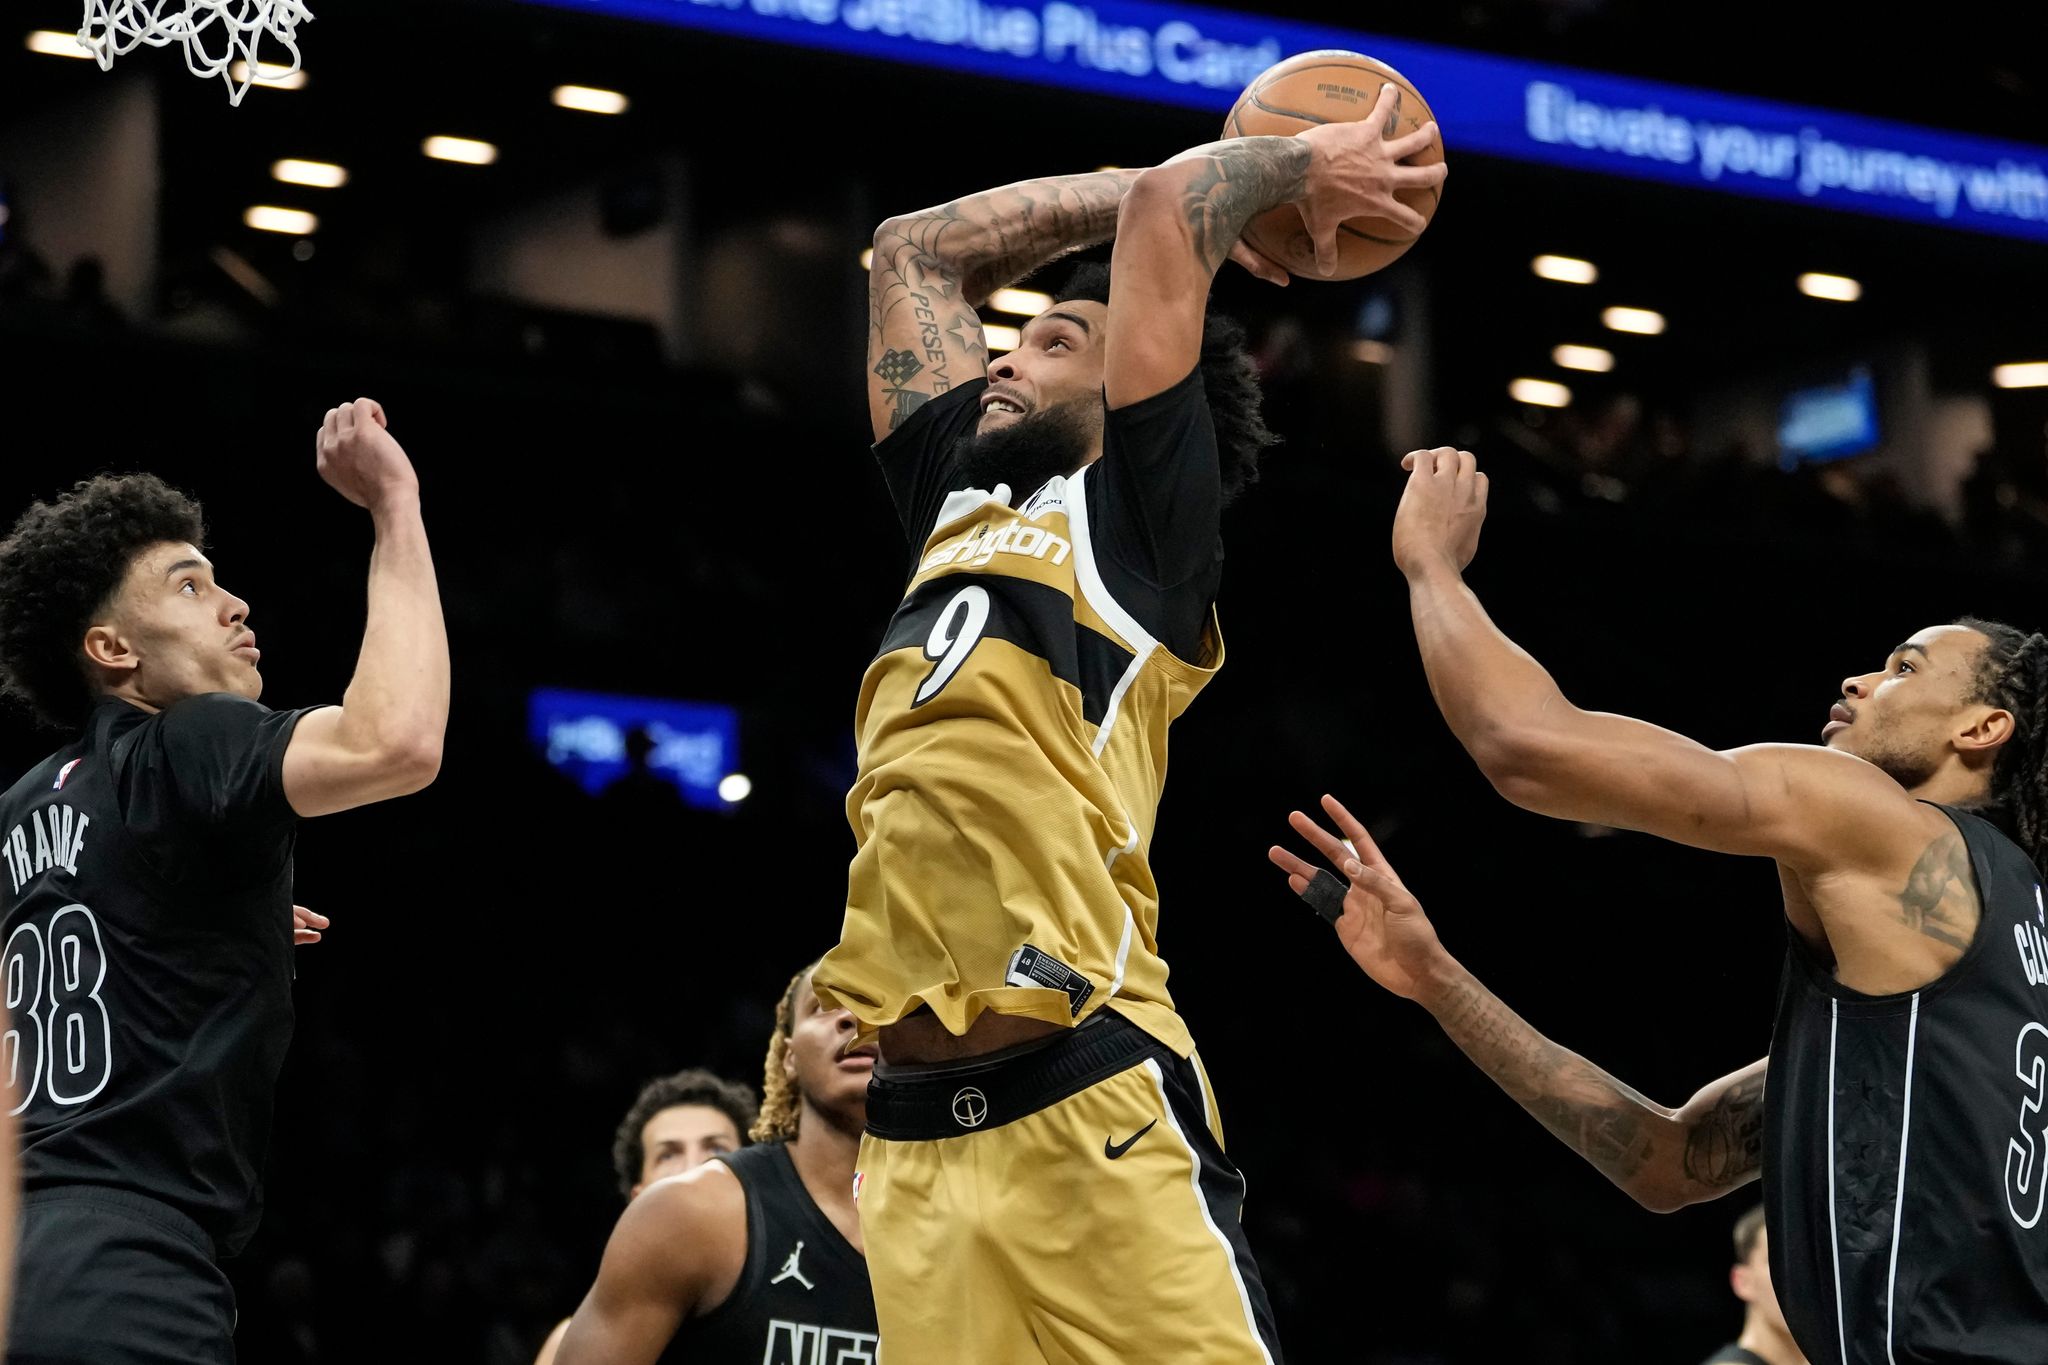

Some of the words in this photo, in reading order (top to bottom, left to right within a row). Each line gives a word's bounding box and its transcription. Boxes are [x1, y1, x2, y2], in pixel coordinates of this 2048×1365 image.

[1043, 2, 1151, 76] Plus
[1526, 81, 1693, 163] Elevate
[1699, 123, 1796, 181] your
[1798, 127, 1962, 219] journey
[912, 584, 990, 708] 9
[2, 804, 90, 895] TRAORE
[0, 903, 111, 1117] 88
